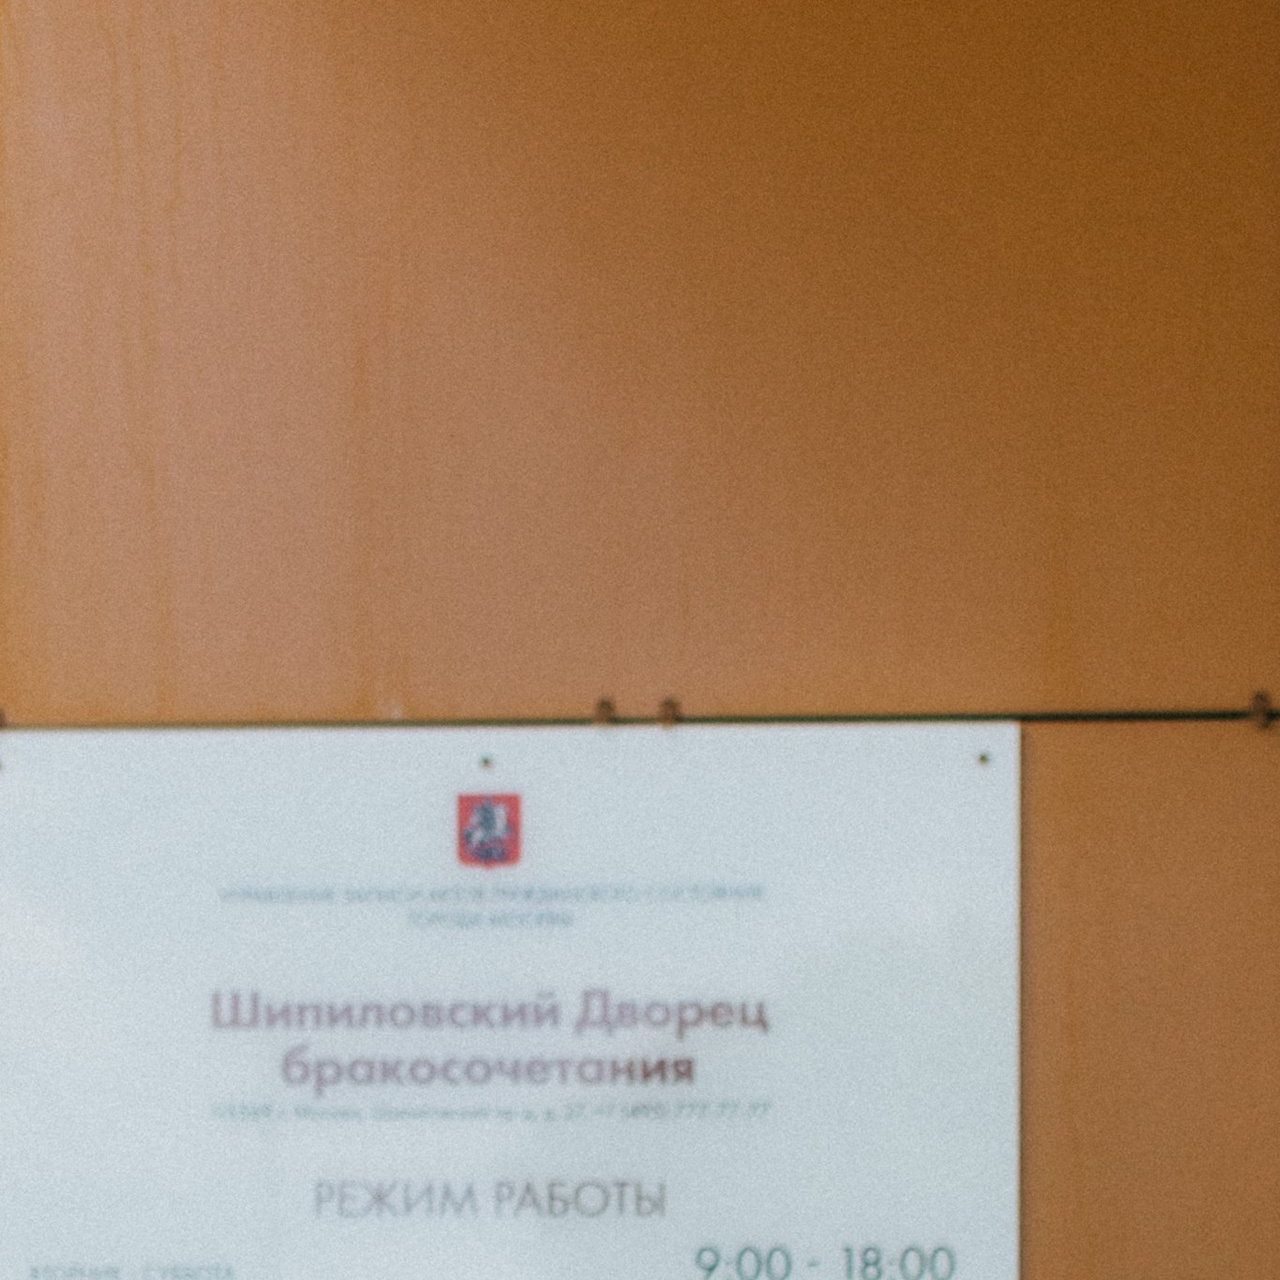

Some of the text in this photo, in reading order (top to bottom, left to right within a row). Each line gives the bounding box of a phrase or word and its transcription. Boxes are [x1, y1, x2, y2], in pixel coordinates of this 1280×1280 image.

[210, 988, 769, 1040] Шипиловский Дворец
[281, 1043, 694, 1098] бракосочетания
[314, 1179, 666, 1218] РЕЖИМ РАБОТЫ
